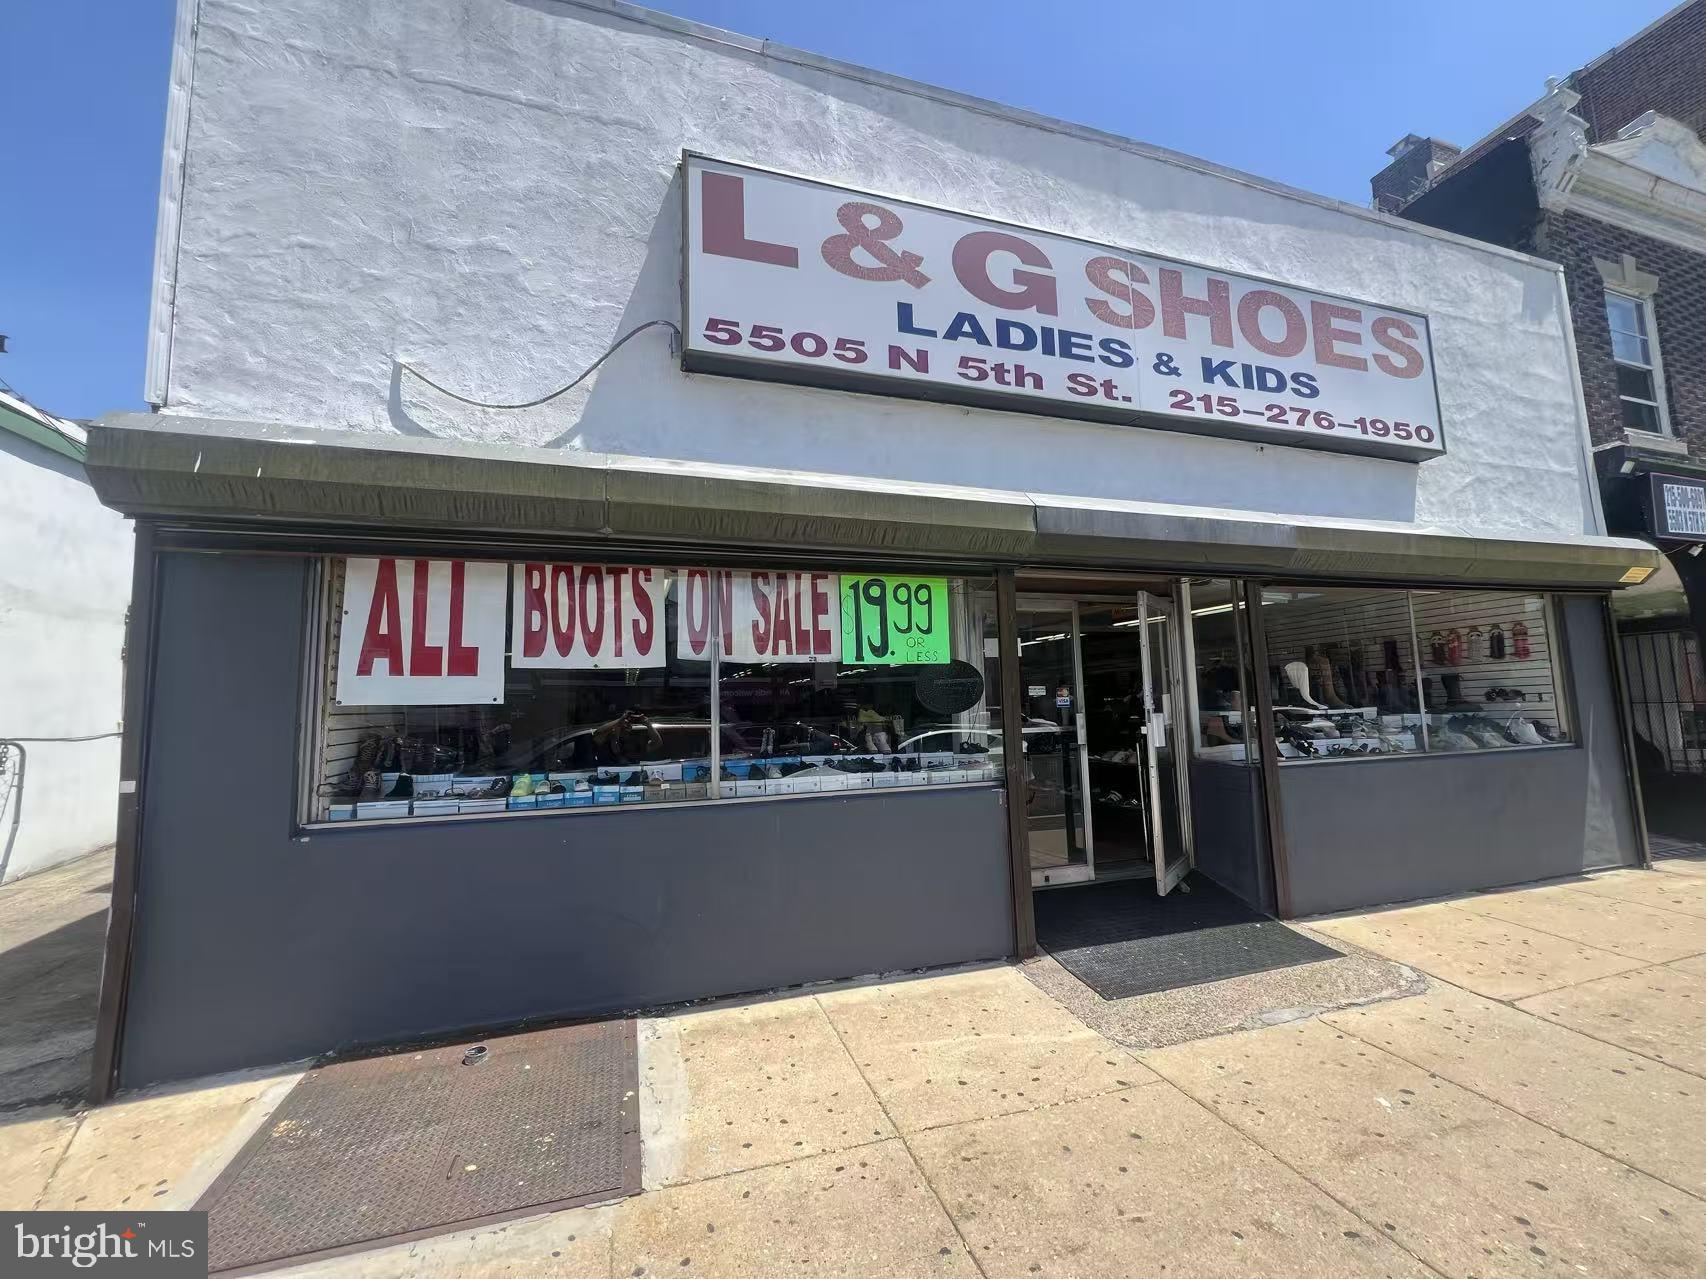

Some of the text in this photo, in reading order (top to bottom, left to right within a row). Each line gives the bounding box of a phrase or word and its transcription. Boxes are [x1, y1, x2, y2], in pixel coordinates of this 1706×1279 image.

[701, 169, 1425, 380] L & G SHOES
[702, 317, 1435, 443] 5505 N 5th St. 215-276-1950
[896, 301, 1320, 399] LADIES & KIDS
[356, 559, 832, 677] ALL BOOTS ON SALE
[906, 636, 925, 648] OR
[906, 650, 939, 662] LESS
